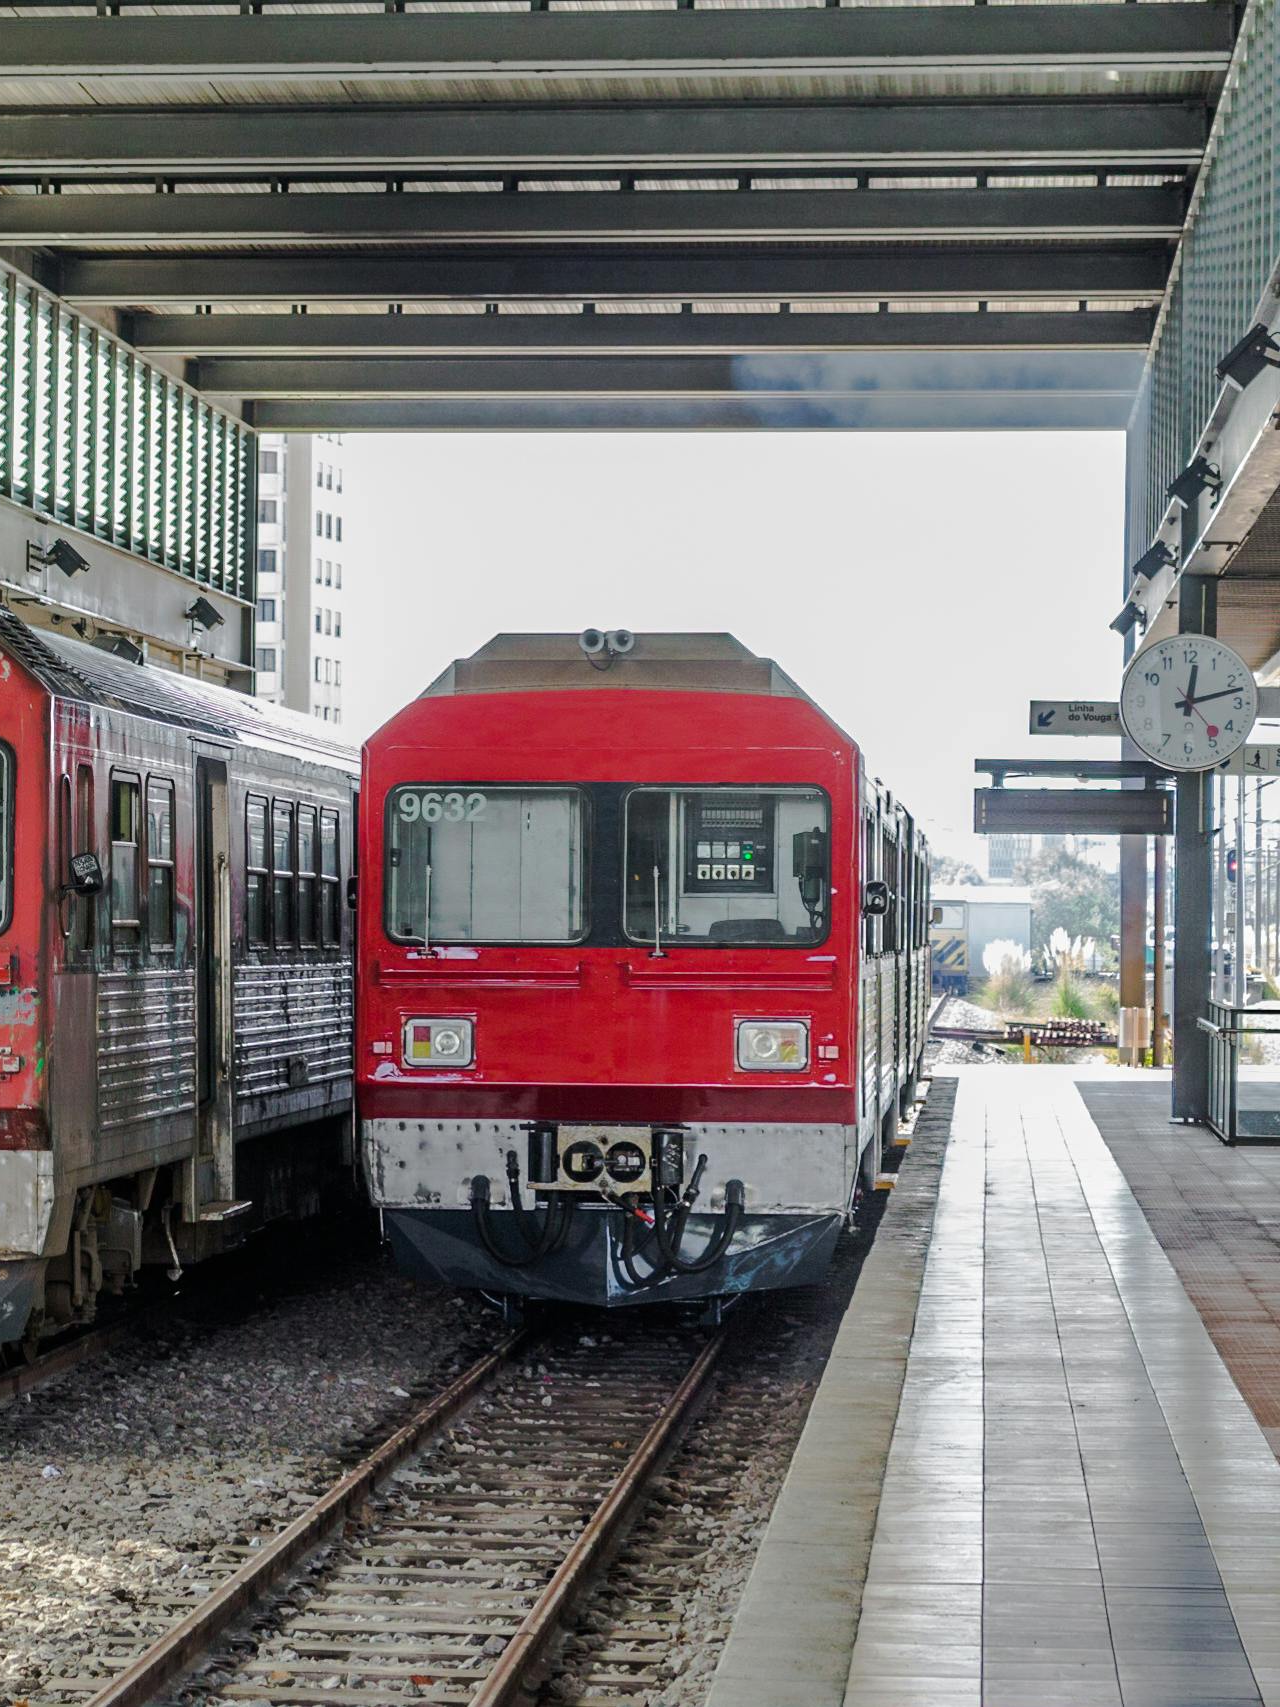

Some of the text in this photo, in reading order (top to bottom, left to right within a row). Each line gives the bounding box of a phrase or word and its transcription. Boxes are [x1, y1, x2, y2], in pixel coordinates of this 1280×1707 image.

[1183, 650, 1198, 663] 12
[1162, 657, 1173, 670] 11
[1211, 658, 1216, 671] 1
[1144, 673, 1160, 686] 10
[1227, 674, 1236, 688] 2
[1068, 704, 1094, 712] Linha
[1233, 697, 1243, 710] 3
[1068, 713, 1080, 721] do
[1083, 714, 1112, 723] Vouga
[1224, 719, 1234, 733] 4
[1161, 733, 1171, 747] 7
[1208, 735, 1218, 748] 5
[1183, 741, 1193, 754] 6
[399, 792, 487, 822] 9632
